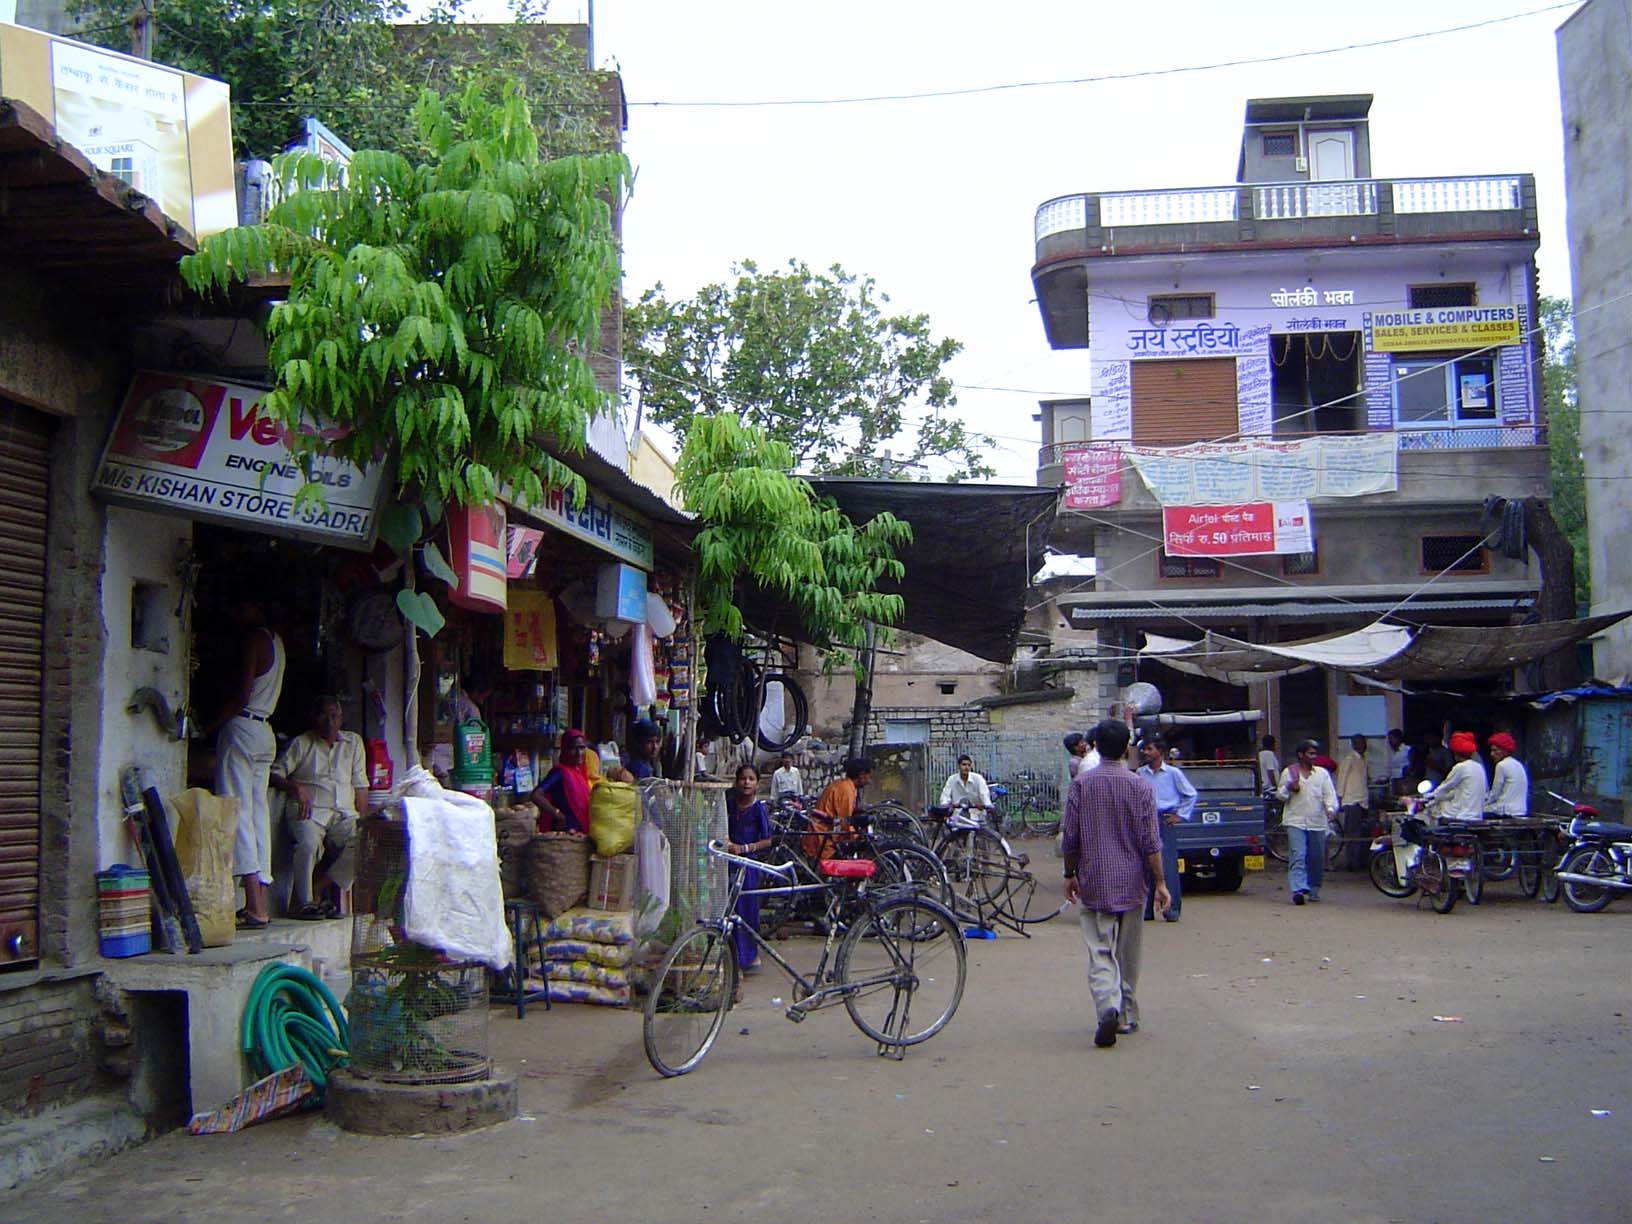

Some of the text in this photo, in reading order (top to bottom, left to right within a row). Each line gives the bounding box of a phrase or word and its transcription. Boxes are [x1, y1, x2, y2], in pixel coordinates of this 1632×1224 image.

[104, 143, 134, 155] SQUARE
[1270, 286, 1354, 308] सोलंकी भवन
[1375, 308, 1514, 327] MOBILE & COMPUTERS
[1411, 324, 1458, 336] SERVICES
[1471, 322, 1514, 333] CLASSES
[1127, 328, 1167, 351] जय
[225, 454, 352, 488] ENGNE OILS
[99, 465, 132, 489] M/s
[136, 473, 216, 504] KISHAN
[1188, 513, 1218, 524] Airtel
